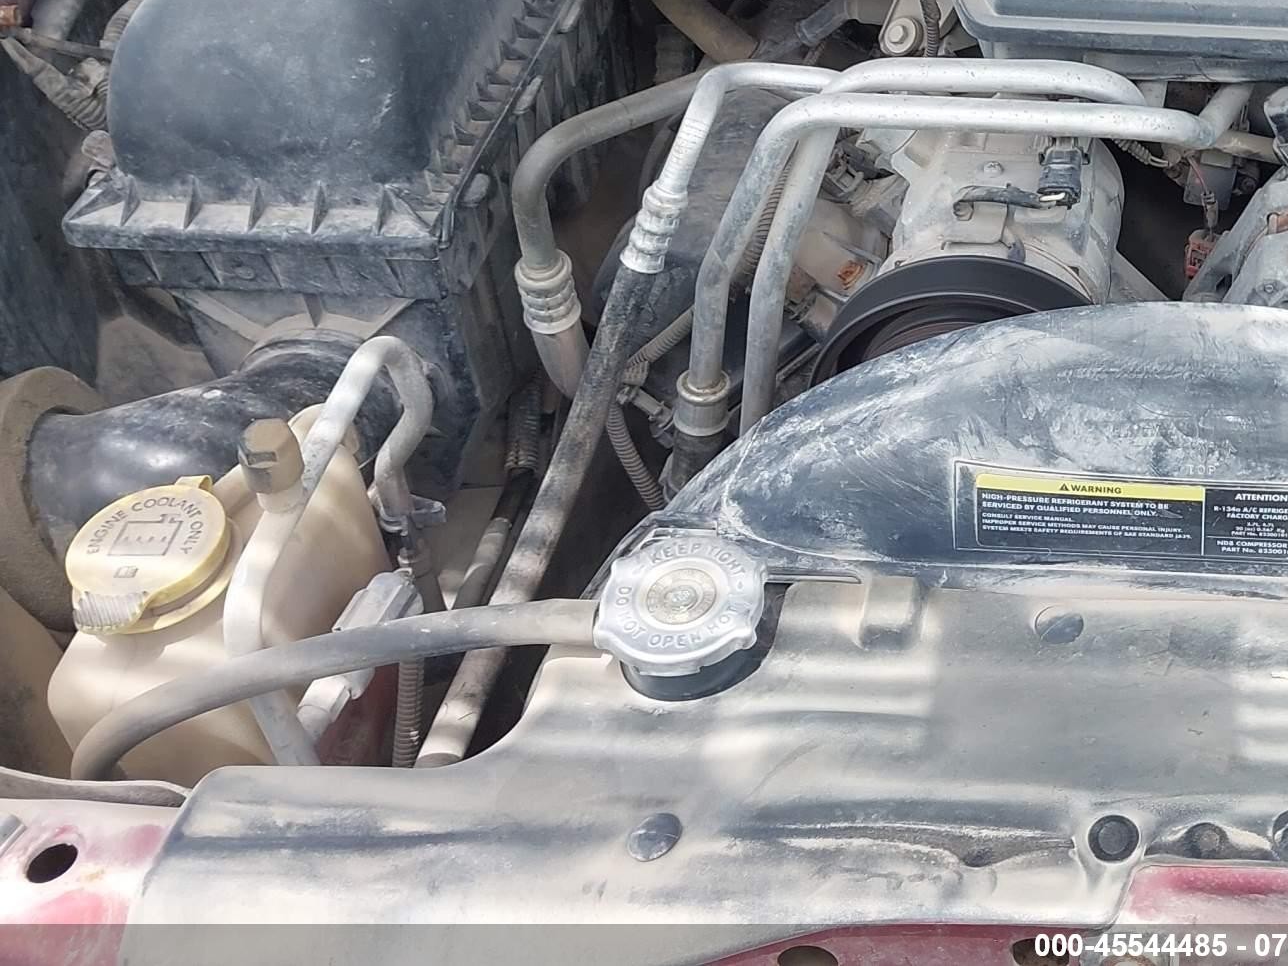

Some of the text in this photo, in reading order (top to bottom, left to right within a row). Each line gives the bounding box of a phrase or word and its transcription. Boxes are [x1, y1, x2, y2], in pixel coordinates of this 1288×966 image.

[1071, 484, 1122, 494] WARNING
[982, 493, 1050, 503] HIGH-PRESSURE
[1051, 497, 1109, 507] REFRIGERANT
[1110, 500, 1143, 509] SYSTEM
[1157, 502, 1169, 510] BE
[1235, 493, 1288, 502] ATTENTION
[982, 501, 1022, 510] SERVICED
[1036, 504, 1081, 513] QUALIFIED
[1082, 507, 1133, 516] PERSONNEL
[982, 512, 1013, 520] CONSULT
[1226, 512, 1260, 520] FACTORY
[1242, 506, 1258, 514] A/C
[86, 497, 204, 555] ENGINE COOLANT ONLY
[1235, 541, 1288, 549] COMPRESSOR
[651, 542, 747, 577] KEEP TIGHT
[616, 586, 632, 607] DO
[617, 610, 647, 640] NOT
[706, 606, 740, 635] HOT
[650, 633, 702, 648] OPEN
